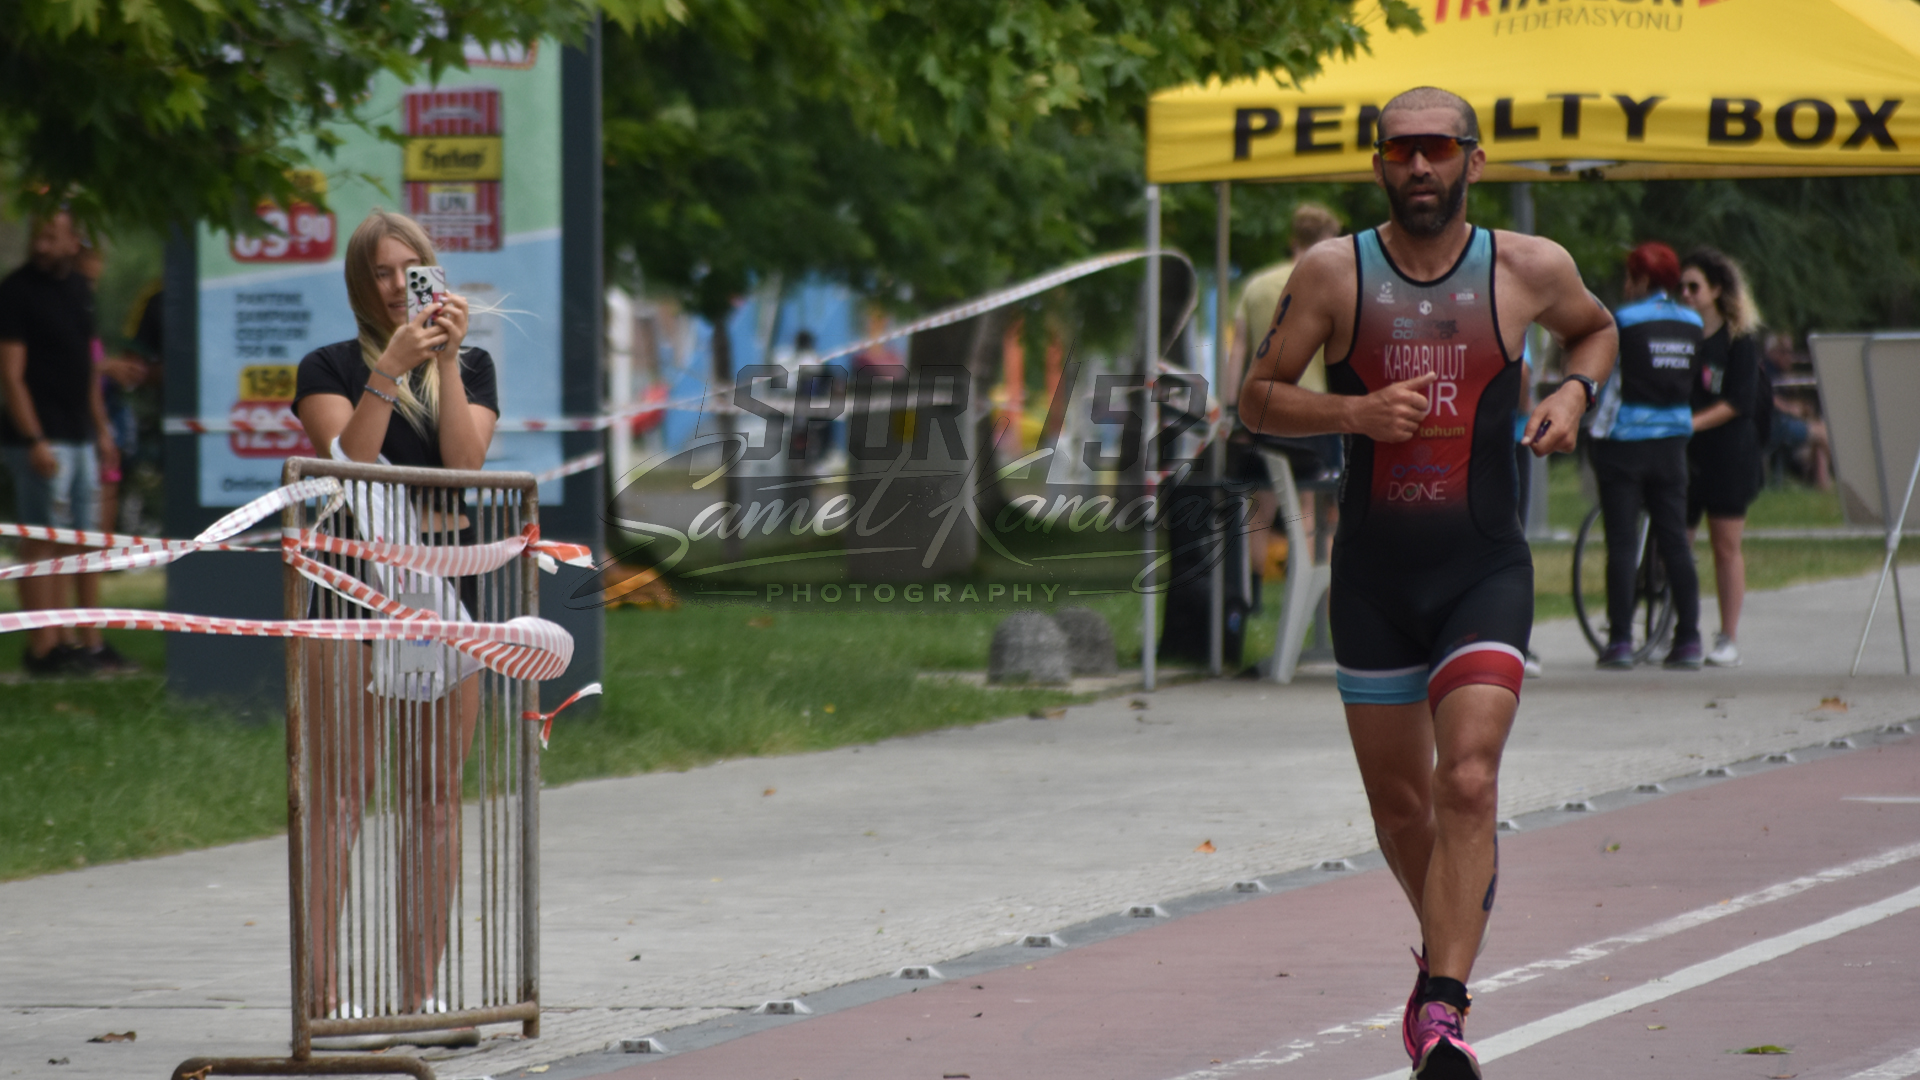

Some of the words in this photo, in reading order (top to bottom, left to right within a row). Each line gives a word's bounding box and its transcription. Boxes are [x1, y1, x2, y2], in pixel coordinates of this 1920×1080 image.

[1493, 7, 1683, 37] FEDERASYONU
[1233, 94, 1666, 162] PELTY
[1708, 97, 1904, 151] BOX
[1648, 341, 1695, 356] TECHNICAL
[1384, 344, 1467, 380] KARABULUT
[1652, 356, 1691, 369] OFFICIAL
[1420, 425, 1465, 437] tohum
[1387, 480, 1447, 501] DONE
